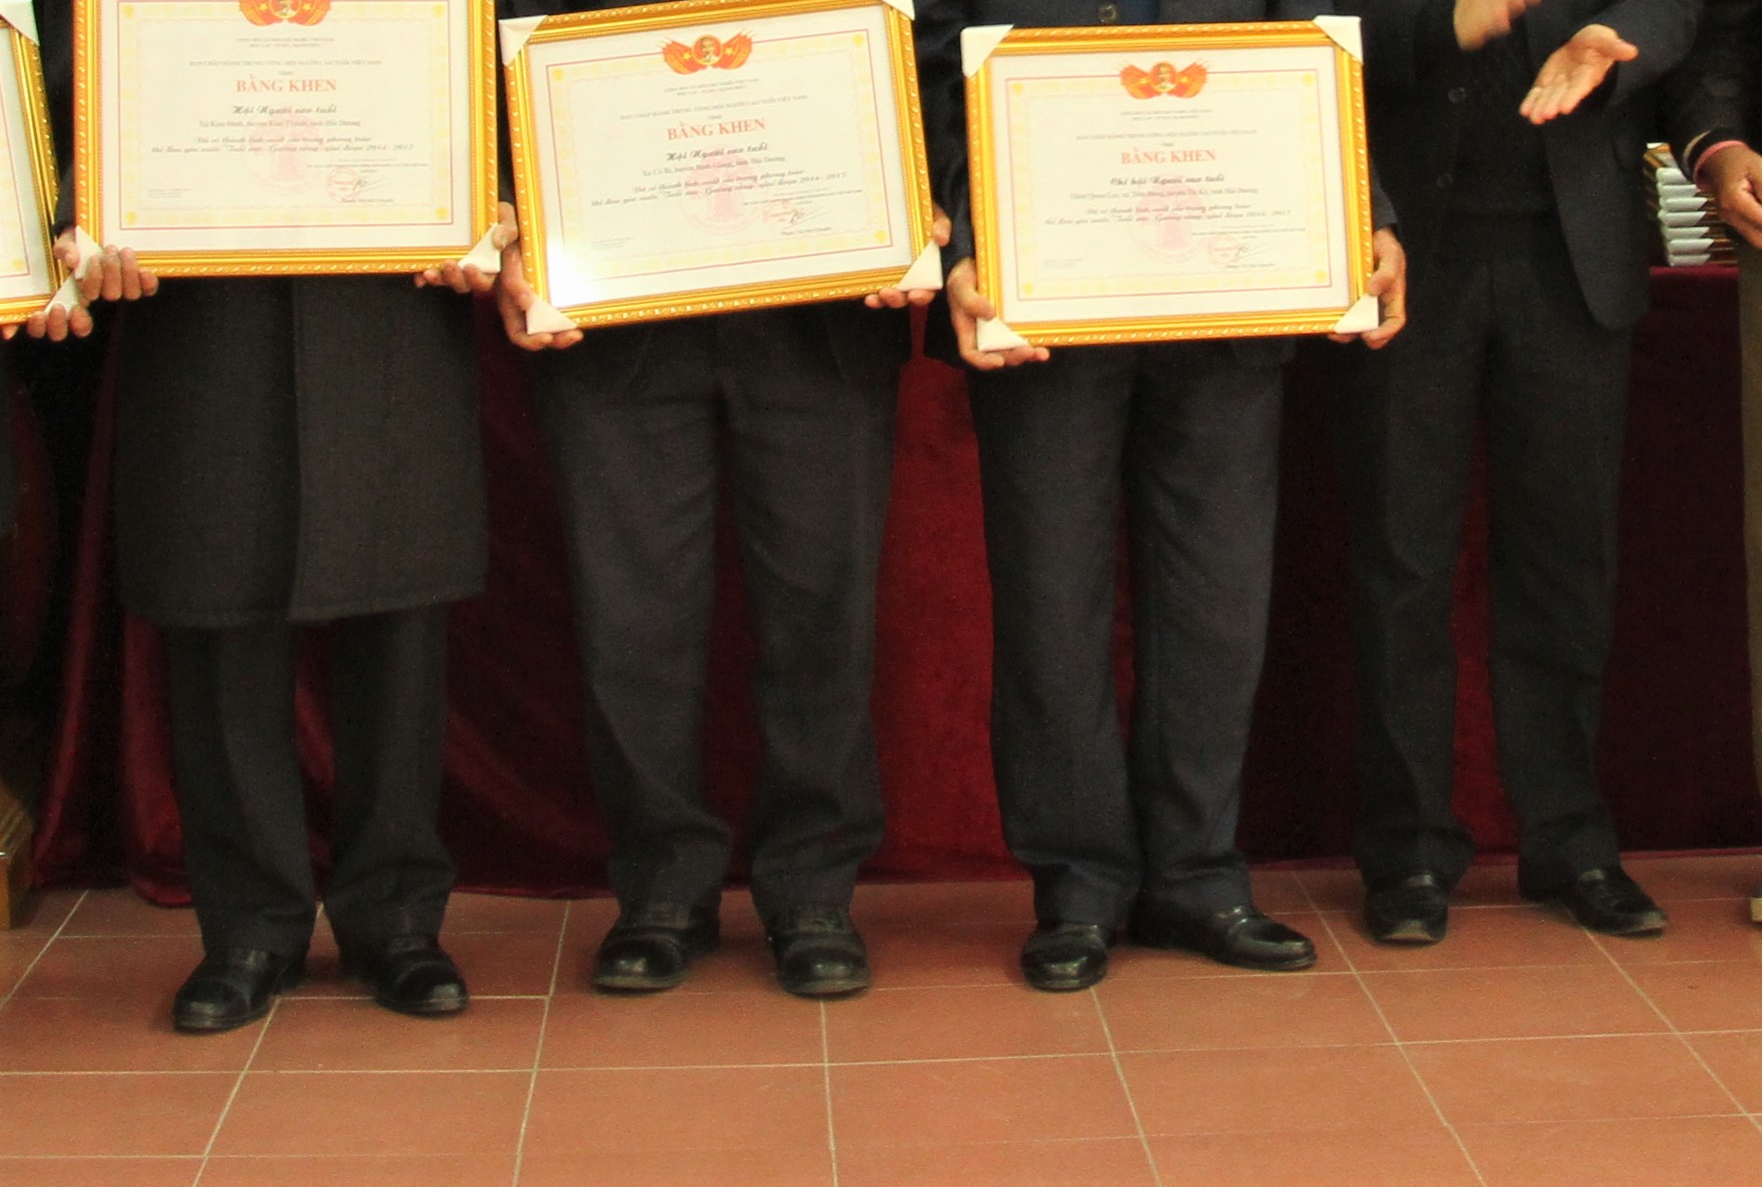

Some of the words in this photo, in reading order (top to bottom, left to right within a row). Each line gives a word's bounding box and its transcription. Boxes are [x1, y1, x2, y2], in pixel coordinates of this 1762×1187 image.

[236, 74, 283, 93] BẰNG
[288, 78, 337, 93] KHEN
[667, 120, 714, 140] BẰNG
[718, 117, 766, 136] KHEN
[1120, 146, 1165, 164] BẰNG
[1170, 149, 1217, 163] KHEN
